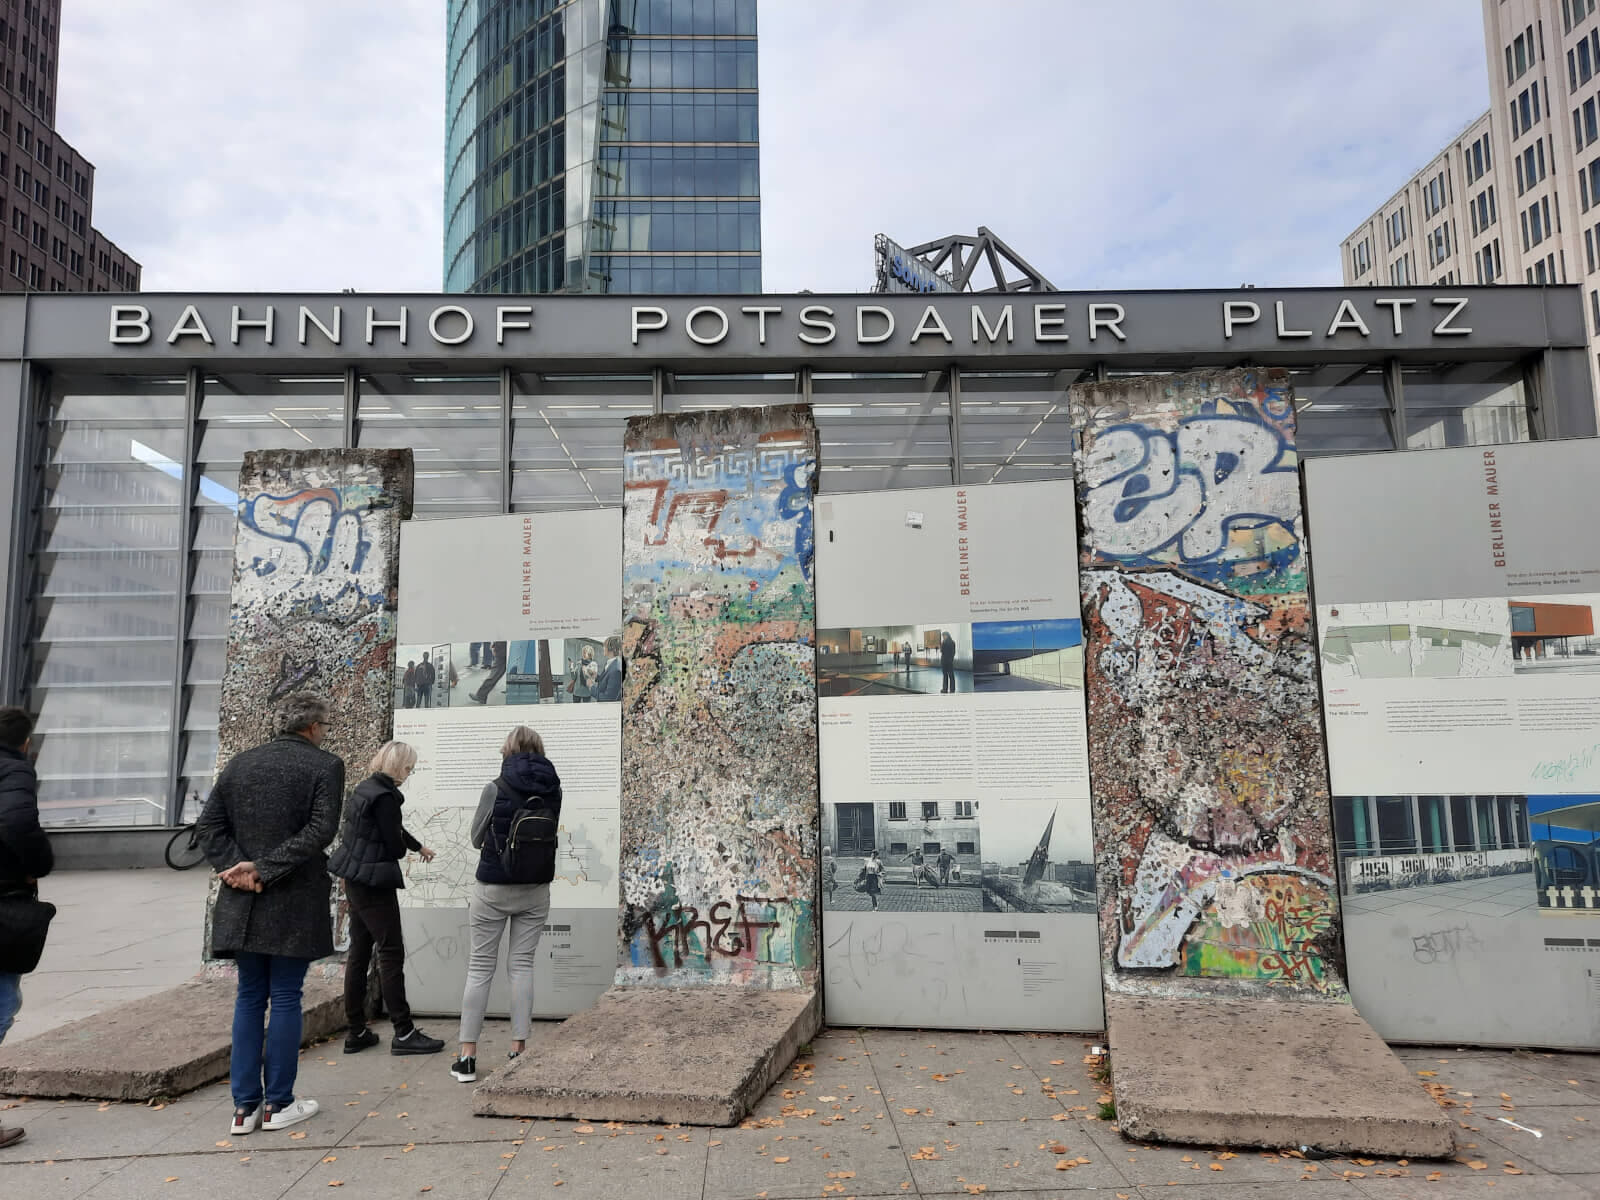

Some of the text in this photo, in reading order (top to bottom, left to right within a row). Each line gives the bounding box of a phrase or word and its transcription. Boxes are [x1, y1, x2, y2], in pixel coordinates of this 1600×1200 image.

[109, 298, 1473, 345] BAHNHOF POTSDAMER PLATZ
[956, 490, 970, 596] BERLINER MAUER
[1483, 450, 1506, 567] BERLINER MAUER
[521, 517, 532, 615] BERLINER MAUER
[1360, 862, 1389, 878] 1959
